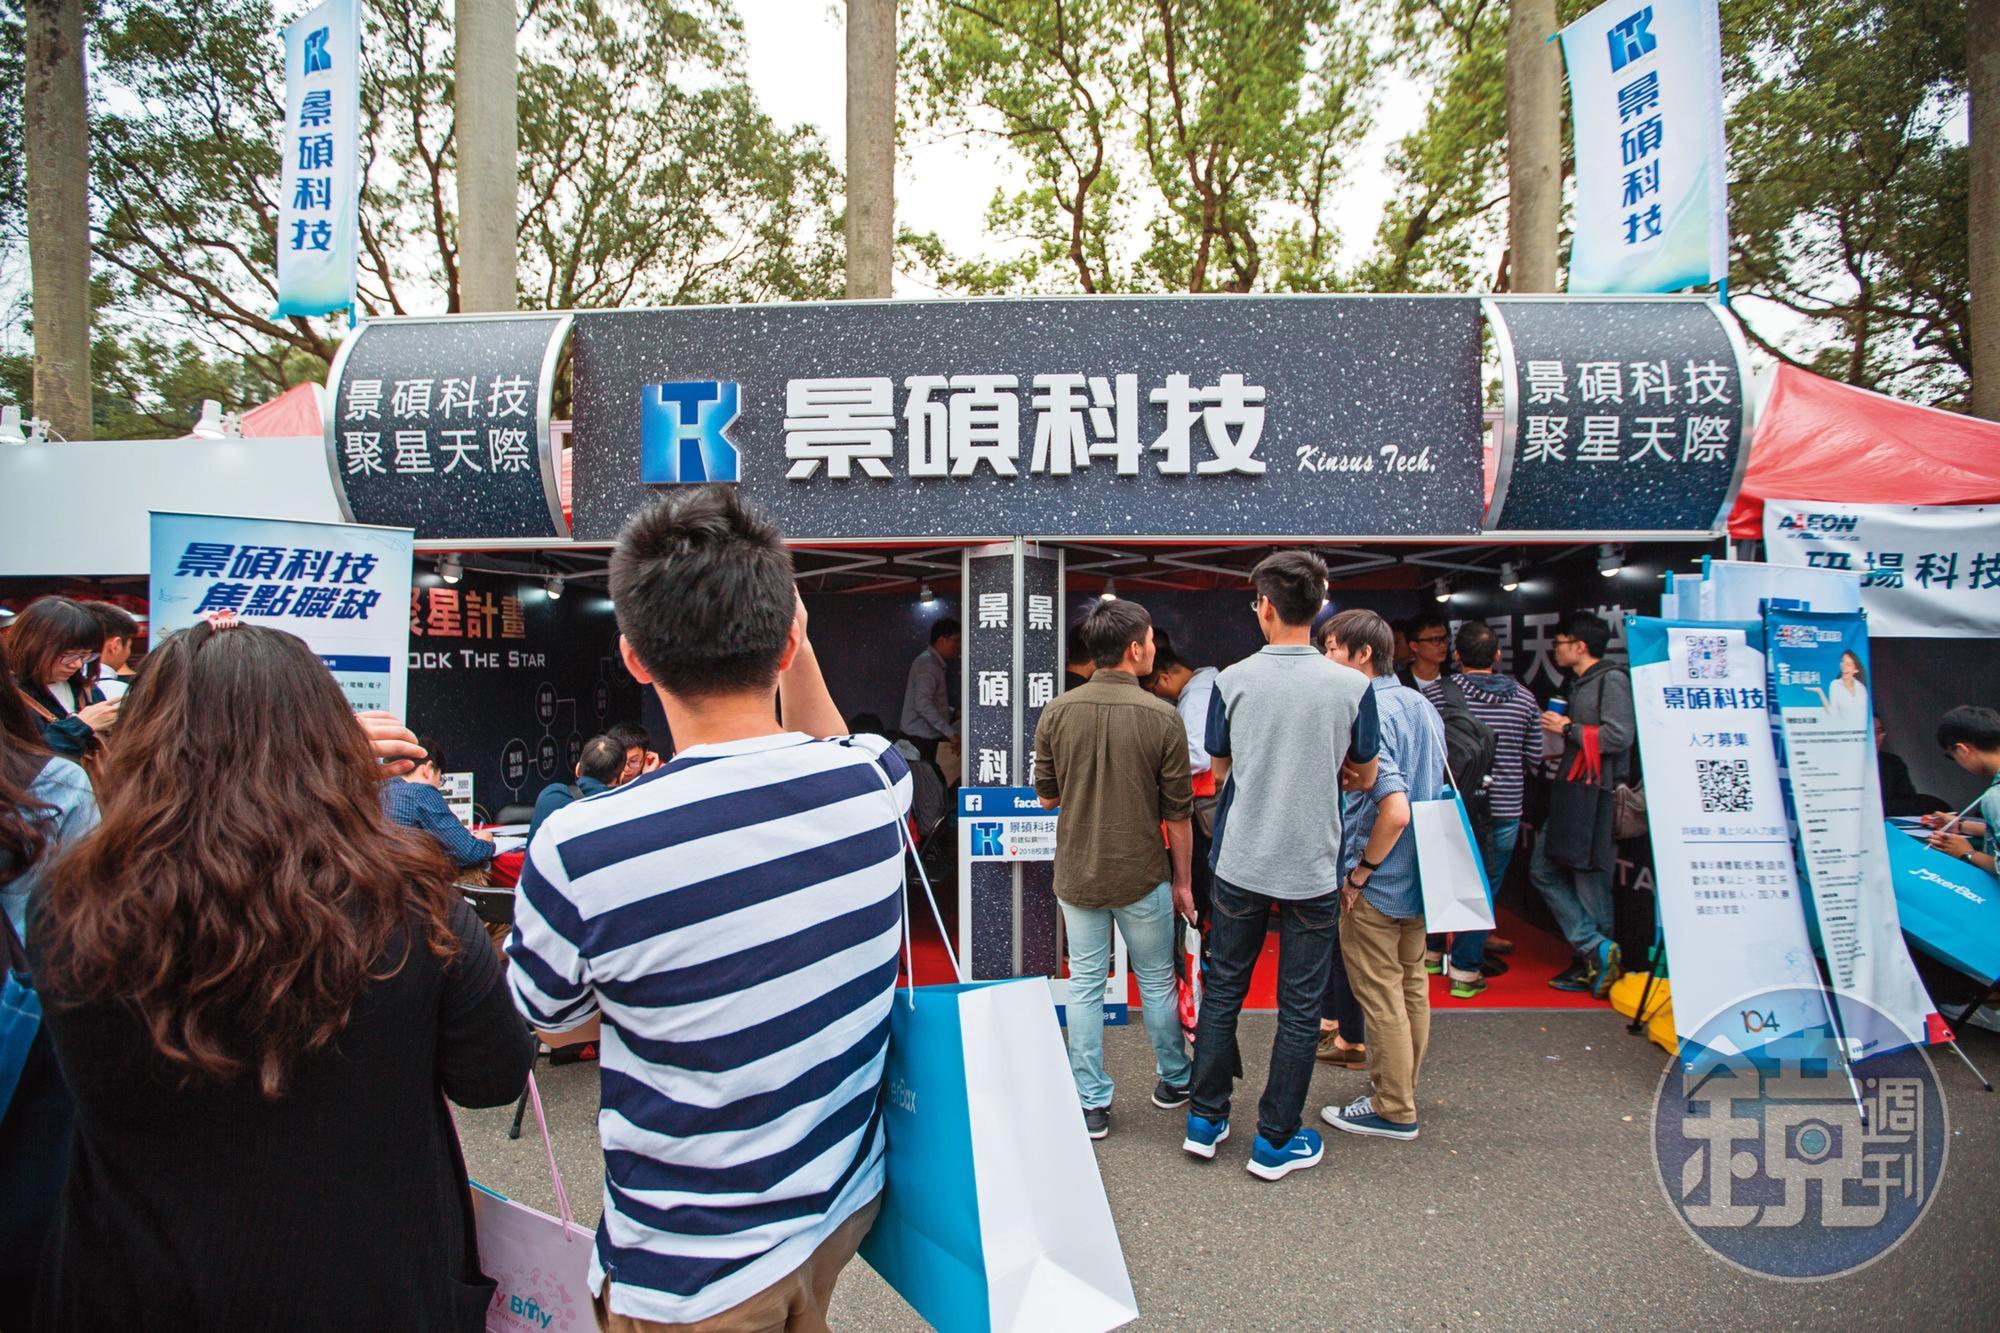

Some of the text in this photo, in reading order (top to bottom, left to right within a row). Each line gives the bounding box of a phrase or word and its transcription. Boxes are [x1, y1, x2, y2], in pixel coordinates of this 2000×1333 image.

[290, 89, 333, 252] 景碩科技
[1617, 70, 1663, 245] 景碩科技
[344, 375, 531, 421] 景碩科技
[1525, 360, 1732, 405] 景碩科技
[783, 372, 1267, 479] 景碩科技
[1522, 415, 1731, 463] 聚星天際
[344, 427, 531, 476] 聚星天際
[1296, 444, 1436, 473] Kinsus Tech.
[174, 542, 379, 584] 景碩科技
[193, 582, 382, 620] 焦點職缺
[408, 650, 546, 669] OCK THE STAR
[1663, 687, 1766, 709] 景碩科技
[1689, 732, 1749, 748] 人才募集
